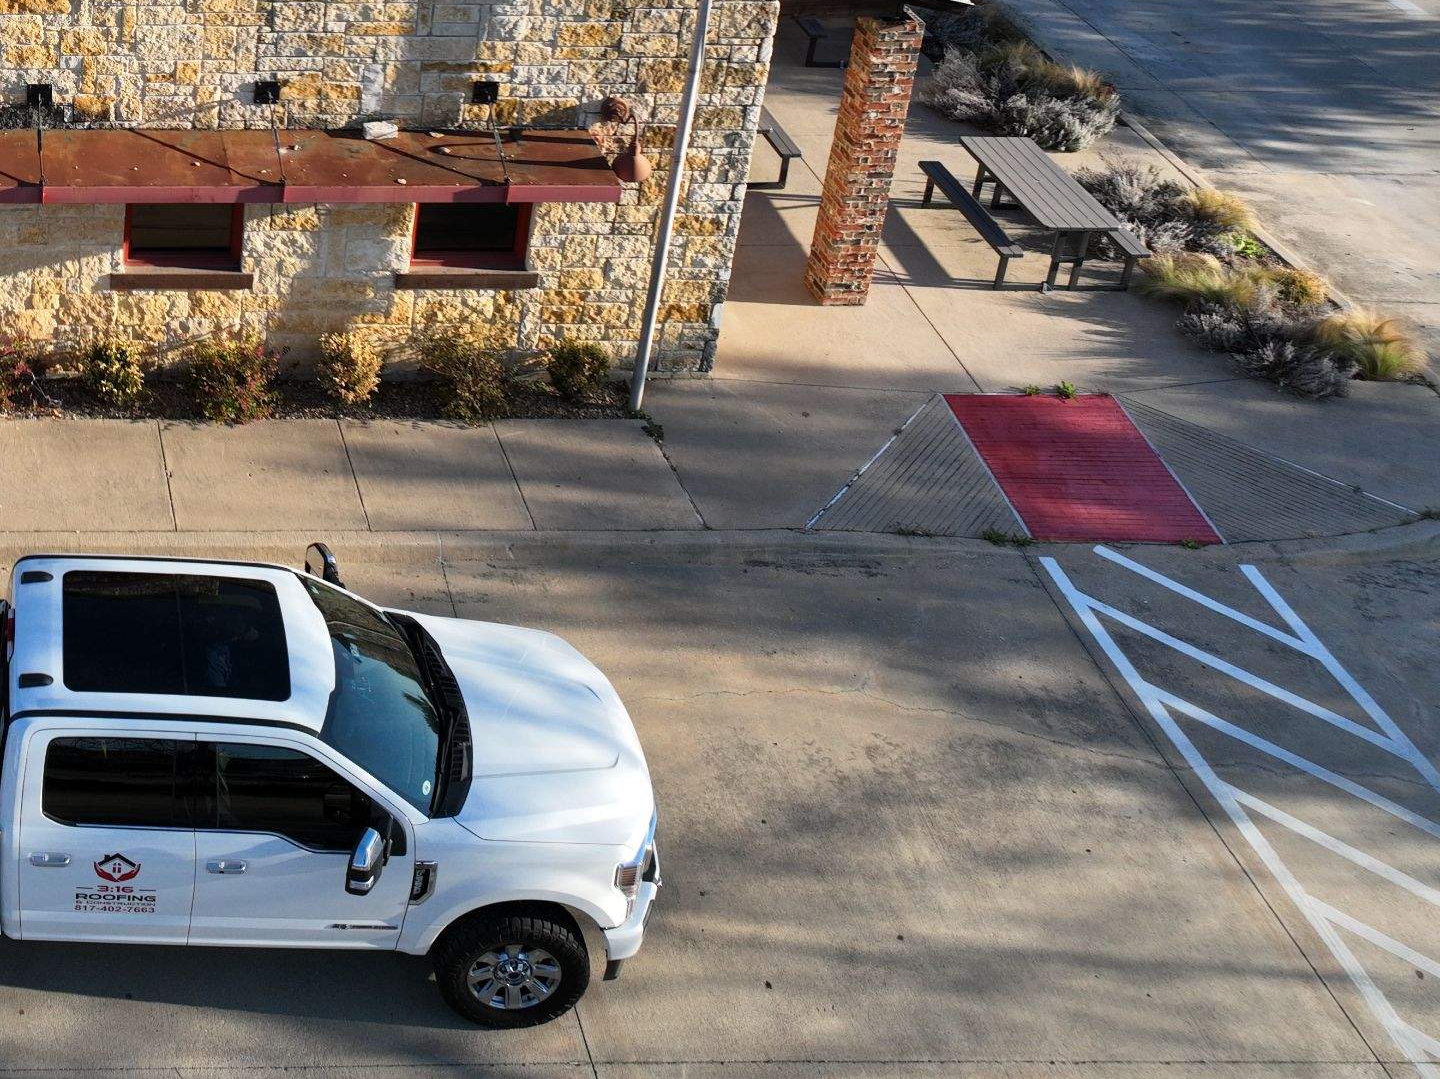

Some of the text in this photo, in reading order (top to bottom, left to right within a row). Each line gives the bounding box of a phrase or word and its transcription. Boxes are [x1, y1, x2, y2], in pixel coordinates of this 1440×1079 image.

[97, 885, 134, 893] 3:16
[75, 893, 157, 902] ROOFING
[74, 905, 156, 914] 817-402-7663
